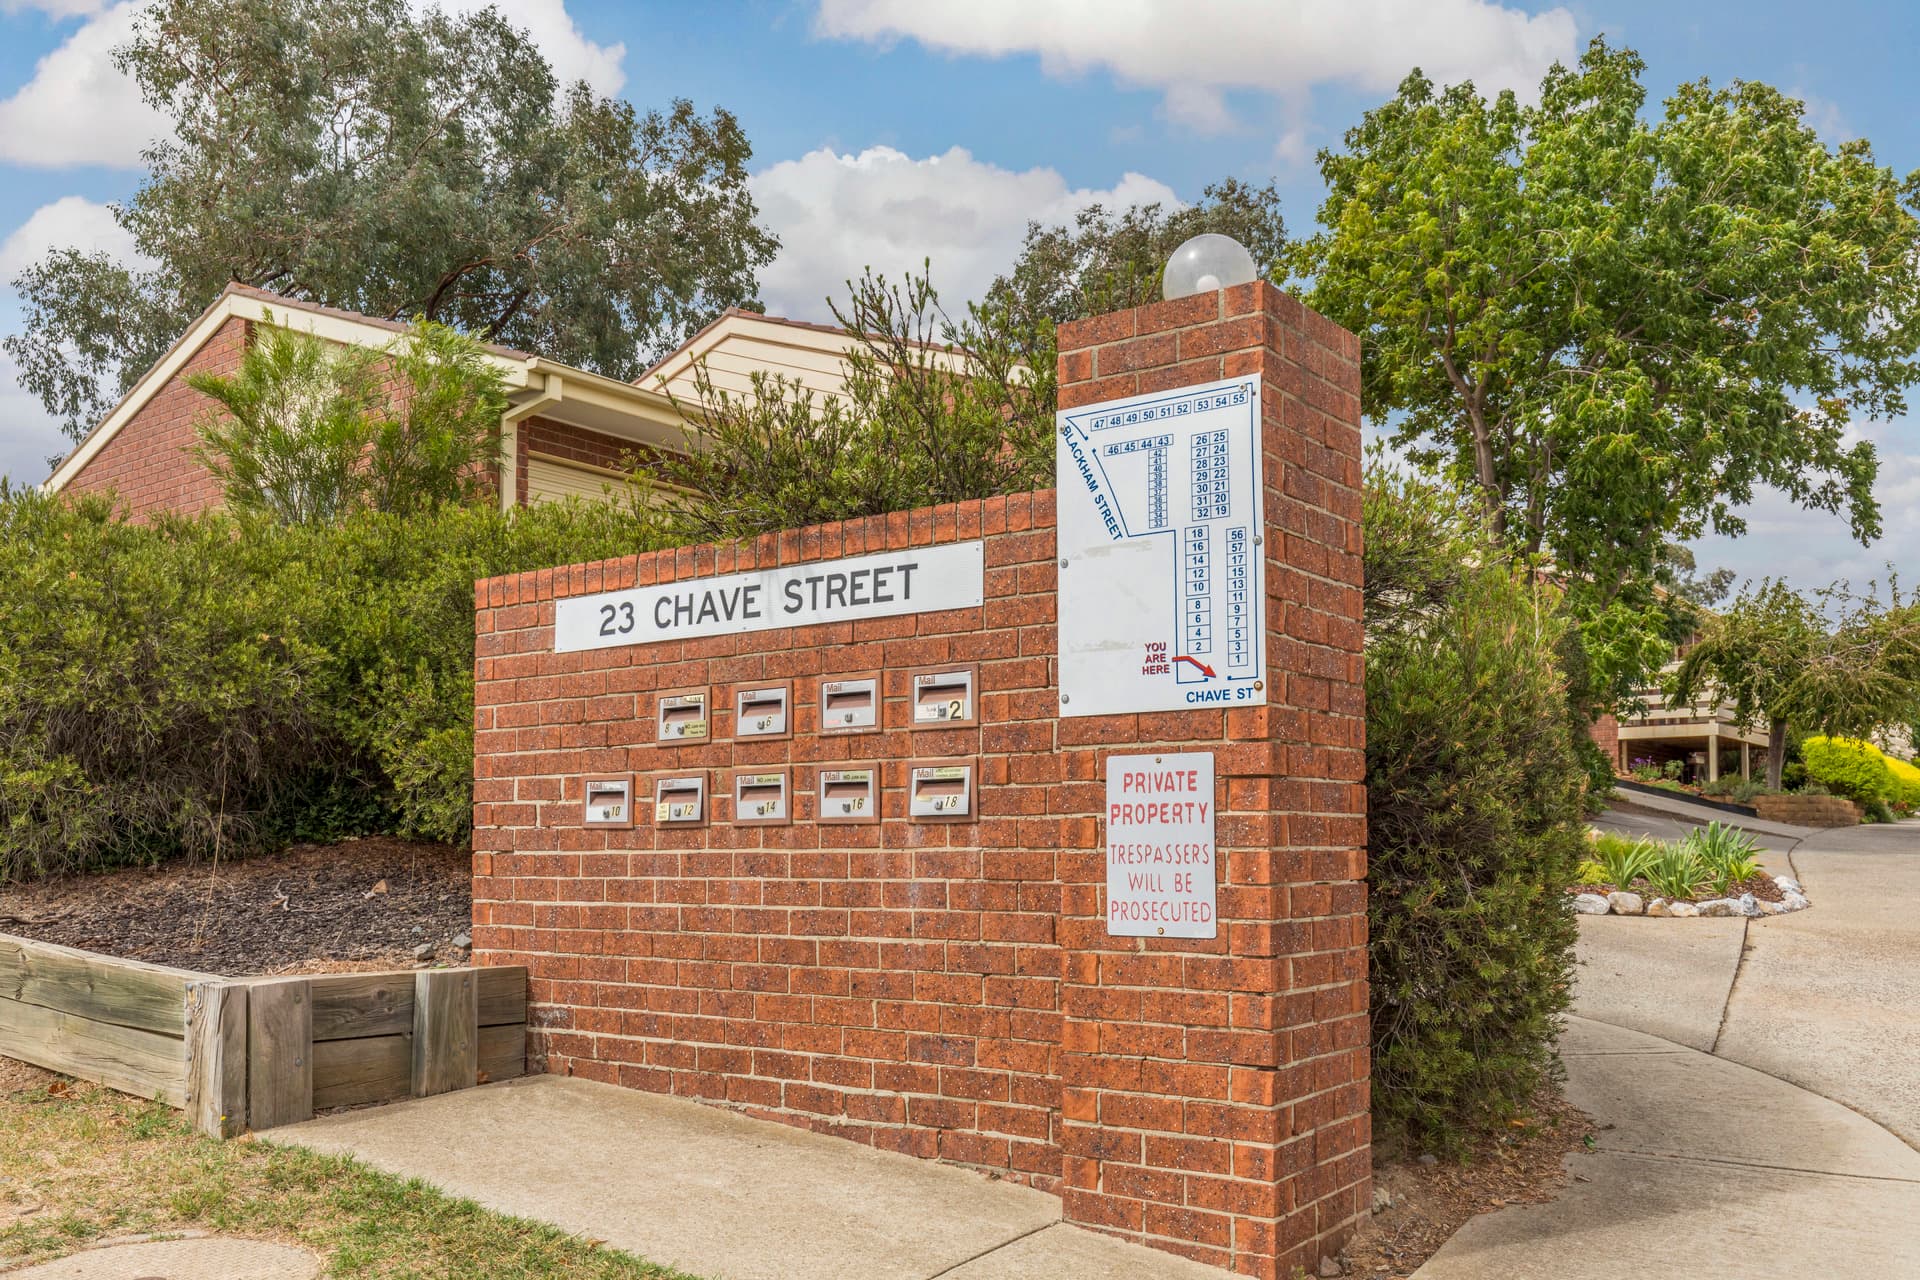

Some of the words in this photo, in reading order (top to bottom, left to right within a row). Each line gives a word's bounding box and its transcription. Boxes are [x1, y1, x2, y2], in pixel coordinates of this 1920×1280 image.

[1094, 419, 1105, 428] 47
[1110, 416, 1121, 425] 48
[1126, 414, 1137, 422] 49
[1143, 411, 1154, 420] 50
[1160, 408, 1171, 416] 51
[1177, 404, 1188, 413] 52
[1198, 400, 1208, 409] 53
[1216, 397, 1227, 406] 54
[1233, 394, 1244, 403] 55
[1196, 436, 1207, 445] 26
[1214, 432, 1225, 441] 25
[1108, 446, 1119, 454] 46
[1125, 443, 1135, 452] 45
[1141, 440, 1152, 449] 44
[1158, 437, 1169, 446] 43
[1196, 448, 1208, 456] 27
[1214, 445, 1225, 454] 24
[1196, 460, 1208, 468] 28
[1214, 457, 1226, 466] 23
[1196, 472, 1208, 480] 29
[1215, 469, 1226, 478] 22
[1063, 425, 1098, 492] BLACKHAM
[1095, 494, 1123, 540] STREET
[1196, 484, 1208, 493] 30
[1215, 481, 1226, 490] 21
[1197, 496, 1208, 504] 31
[1215, 494, 1226, 503] 20
[1197, 508, 1208, 517] 32
[1216, 506, 1226, 515] 19
[1192, 529, 1203, 538] 18
[1232, 530, 1243, 539] 56
[1193, 543, 1203, 551] 16
[1232, 543, 1243, 552] 57
[1193, 556, 1203, 564] 14
[1232, 555, 1243, 564] 17
[1193, 570, 1204, 578] 12
[1232, 567, 1244, 576] 15
[1193, 583, 1204, 592] 10
[1233, 580, 1244, 588] 13
[600, 601, 635, 636] 23
[654, 584, 761, 629] CHAVE
[783, 563, 918, 614] STREET
[1233, 592, 1243, 601] 11
[1195, 601, 1201, 609] 8
[1234, 605, 1240, 614] 9
[1196, 614, 1201, 623] 6
[1235, 617, 1240, 626] 7
[1195, 628, 1201, 636] 4
[1235, 630, 1240, 638] 5
[1145, 642, 1166, 652] YOU
[1235, 642, 1240, 650] 3
[1145, 654, 1166, 664] ARE
[1236, 654, 1240, 663] 1
[1142, 665, 1170, 675] HERE
[919, 676, 935, 685] Mail
[827, 684, 842, 692] Mail
[1186, 689, 1230, 703] CHAVE
[1237, 688, 1254, 699] ST
[950, 701, 962, 719] 2
[766, 716, 771, 726] 6
[665, 723, 670, 733] 8
[824, 772, 840, 780] Mail
[917, 768, 933, 777] Mail
[740, 776, 754, 784] Mail
[1123, 770, 1197, 793] PRIVATE
[766, 801, 775, 812] 14
[852, 798, 863, 810] 16
[946, 796, 957, 807] 18
[612, 806, 620, 816] 10
[684, 805, 693, 815] 12
[1110, 802, 1208, 825] PROPERTY
[1111, 844, 1209, 864] TRESPASSERS
[1128, 872, 1163, 892] WILL
[1175, 873, 1192, 893] BE
[1111, 901, 1211, 922] PROSECUTED
